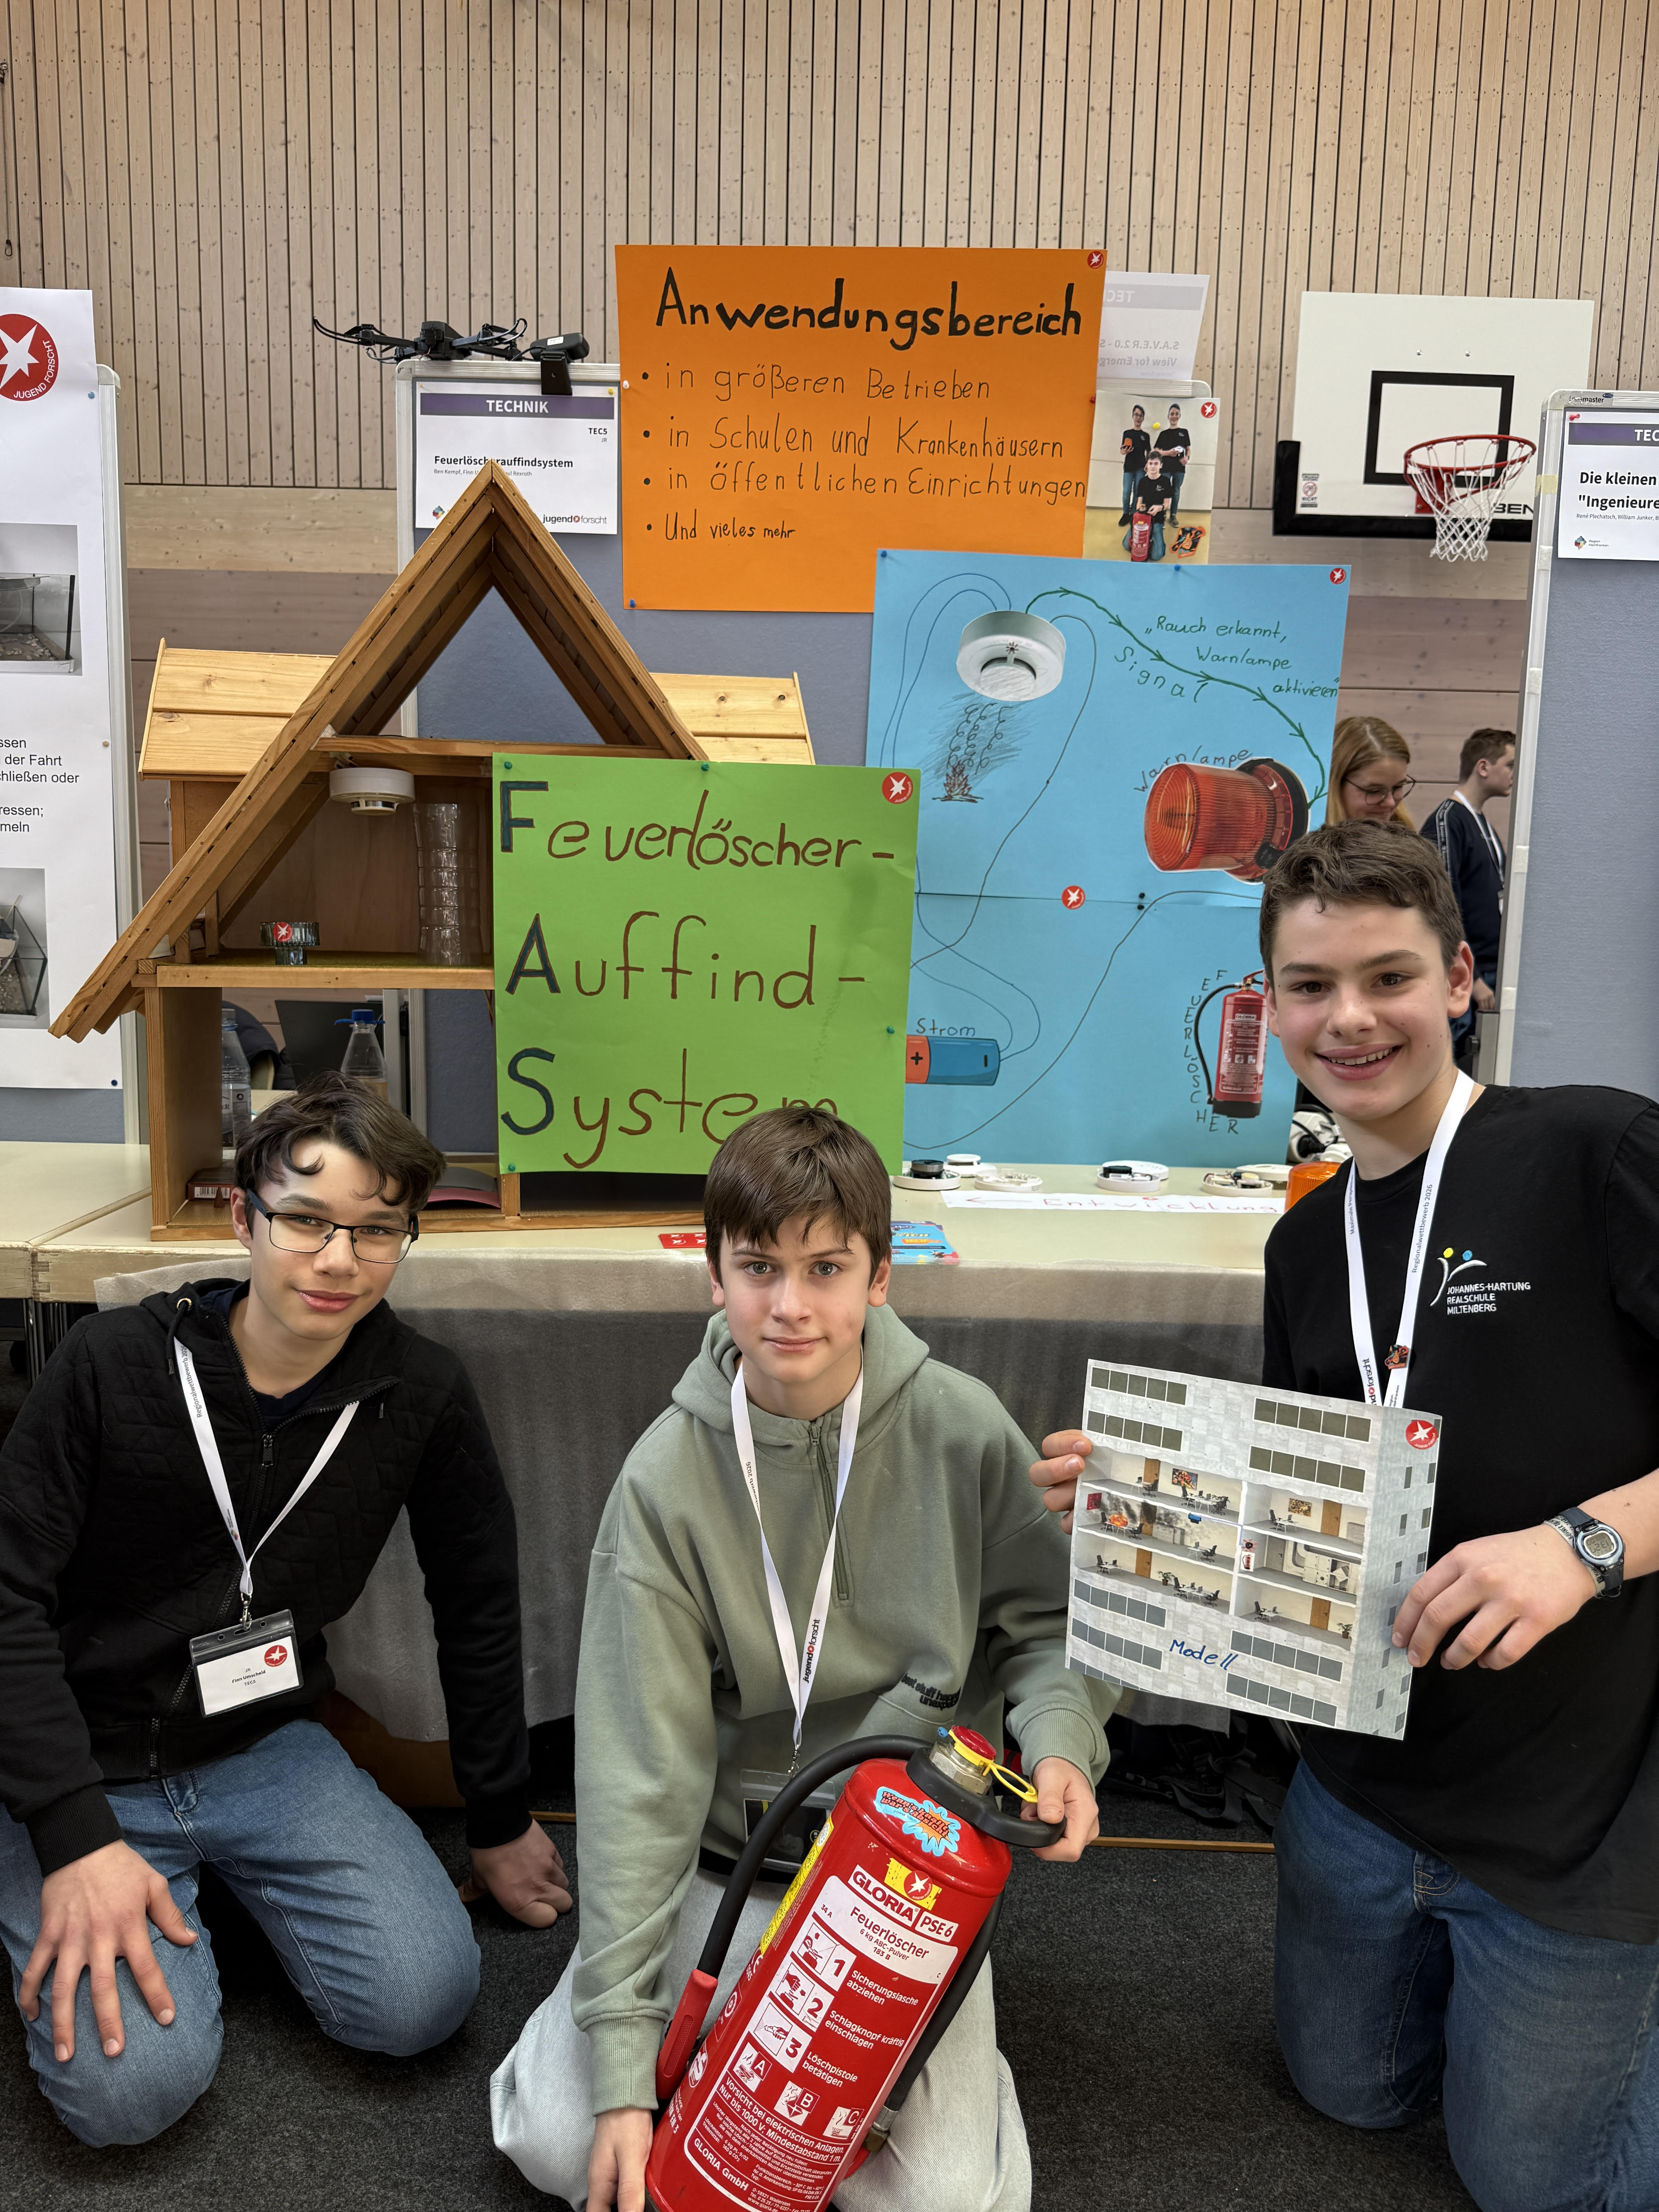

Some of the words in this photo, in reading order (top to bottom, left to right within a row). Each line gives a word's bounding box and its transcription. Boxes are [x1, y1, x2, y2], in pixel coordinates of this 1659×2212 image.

[656, 267, 1082, 351] Anwendungsbereich
[14, 383, 46, 398] JUGEND
[44, 340, 55, 383] FORSCHT
[666, 362, 694, 379] in
[714, 364, 845, 401] größeren
[866, 367, 990, 400] Betrieben
[486, 400, 549, 413] TECHNIK
[668, 415, 689, 449] in
[709, 412, 813, 453] Schulen
[831, 417, 870, 457] und
[896, 416, 1063, 459] Krankenhäusern
[434, 455, 573, 469] Feuerlöschrauffindsystem
[668, 467, 687, 490] in
[710, 462, 897, 495] öffentlichen
[908, 464, 1085, 505] Einrichtungen
[1580, 471, 1602, 484] Die
[1606, 472, 1656, 485] kleinen
[543, 514, 573, 524] jugend
[581, 516, 607, 524] forscht
[665, 508, 697, 541] Und
[709, 520, 756, 539] vieles
[763, 525, 796, 539] mehr
[1216, 621, 1287, 643] erkannt,
[1196, 647, 1292, 670] Warnlampe
[5, 754, 25, 765] der
[29, 754, 62, 766] Fahrt
[1133, 745, 1253, 792] Warnlampe
[0, 771, 47, 782] hließen
[51, 772, 79, 783] oder
[505, 911, 865, 1009] Auffind-
[916, 1017, 976, 1037] Strom
[1412, 1202, 1429, 1273] Regionalwettbewerb
[1447, 1282, 1531, 1295] JOHANNES-HARTUNG
[1447, 1293, 1496, 1305] REALSCHULE
[1447, 1303, 1497, 1315] MILTENBERG
[1362, 1358, 1374, 1387] forscht
[182, 1357, 203, 1418] Regionalwettbewerb
[803, 1652, 814, 1684] jugend
[809, 1619, 821, 1645] forscht
[1169, 1639, 1239, 1671] Modell
[882, 1791, 918, 1811] Wenn's
[880, 1798, 911, 1814] war's
[909, 1810, 949, 1838] Absicht
[821, 1904, 828, 1913] 34
[853, 1871, 915, 1922] GLORIA
[850, 1906, 929, 1958] Feuerlöscher
[865, 1932, 874, 1941] kg
[874, 1939, 909, 1960] ABC-Pulver
[874, 1947, 885, 1956] 183
[834, 1960, 845, 1977] 1
[852, 1970, 918, 2005] Sicherungslasche
[847, 1980, 884, 2004] abziehen
[807, 1998, 823, 2018] 2
[830, 2010, 882, 2040] Schlagknopf
[881, 2035, 905, 2047] kräftig
[825, 2020, 874, 2049] einschlagen
[754, 2060, 766, 2076] A
[786, 2037, 802, 2058] 3
[805, 2052, 857, 2081] Löschpistole
[802, 2060, 843, 2087] betätigen
[800, 2093, 813, 2107] B
[704, 2117, 723, 2139] Löschmittel:
[719, 2084, 732, 2100] Nur
[728, 2097, 741, 2111] bis
[738, 2109, 758, 2126] 1000
[759, 2122, 766, 2133] V;
[766, 2129, 831, 2161] Mindestabstand
[830, 2152, 834, 2162] 1
[833, 2156, 840, 2164] m.
[726, 2077, 755, 2109] Vorsicht
[752, 2105, 768, 2119] bei
[766, 2117, 814, 2147] elektrischen
[814, 2142, 843, 2154] Anlagen.
[848, 2111, 860, 2124] C
[703, 2121, 722, 2143] Treibmittel:
[713, 2101, 725, 2116] Löscher
[725, 2115, 742, 2134] längstens
[753, 2141, 764, 2150] Jahre
[773, 2154, 812, 2172] Einsatzbereitschaft
[740, 2124, 751, 2134] Nach
[750, 2132, 762, 2142] jeder
[762, 2141, 785, 2157] Betätigung
[723, 2120, 734, 2133] solche
[780, 2163, 802, 2175] Ersatzteile
[732, 2136, 741, 2145] dem
[741, 2145, 767, 2164] anerkannten
[768, 2162, 783, 2172] Muster
[694, 2138, 720, 2171] GLORIA
[722, 2168, 749, 2191] GmbH
[756, 2164, 791, 2185] Funktionsbereich:
